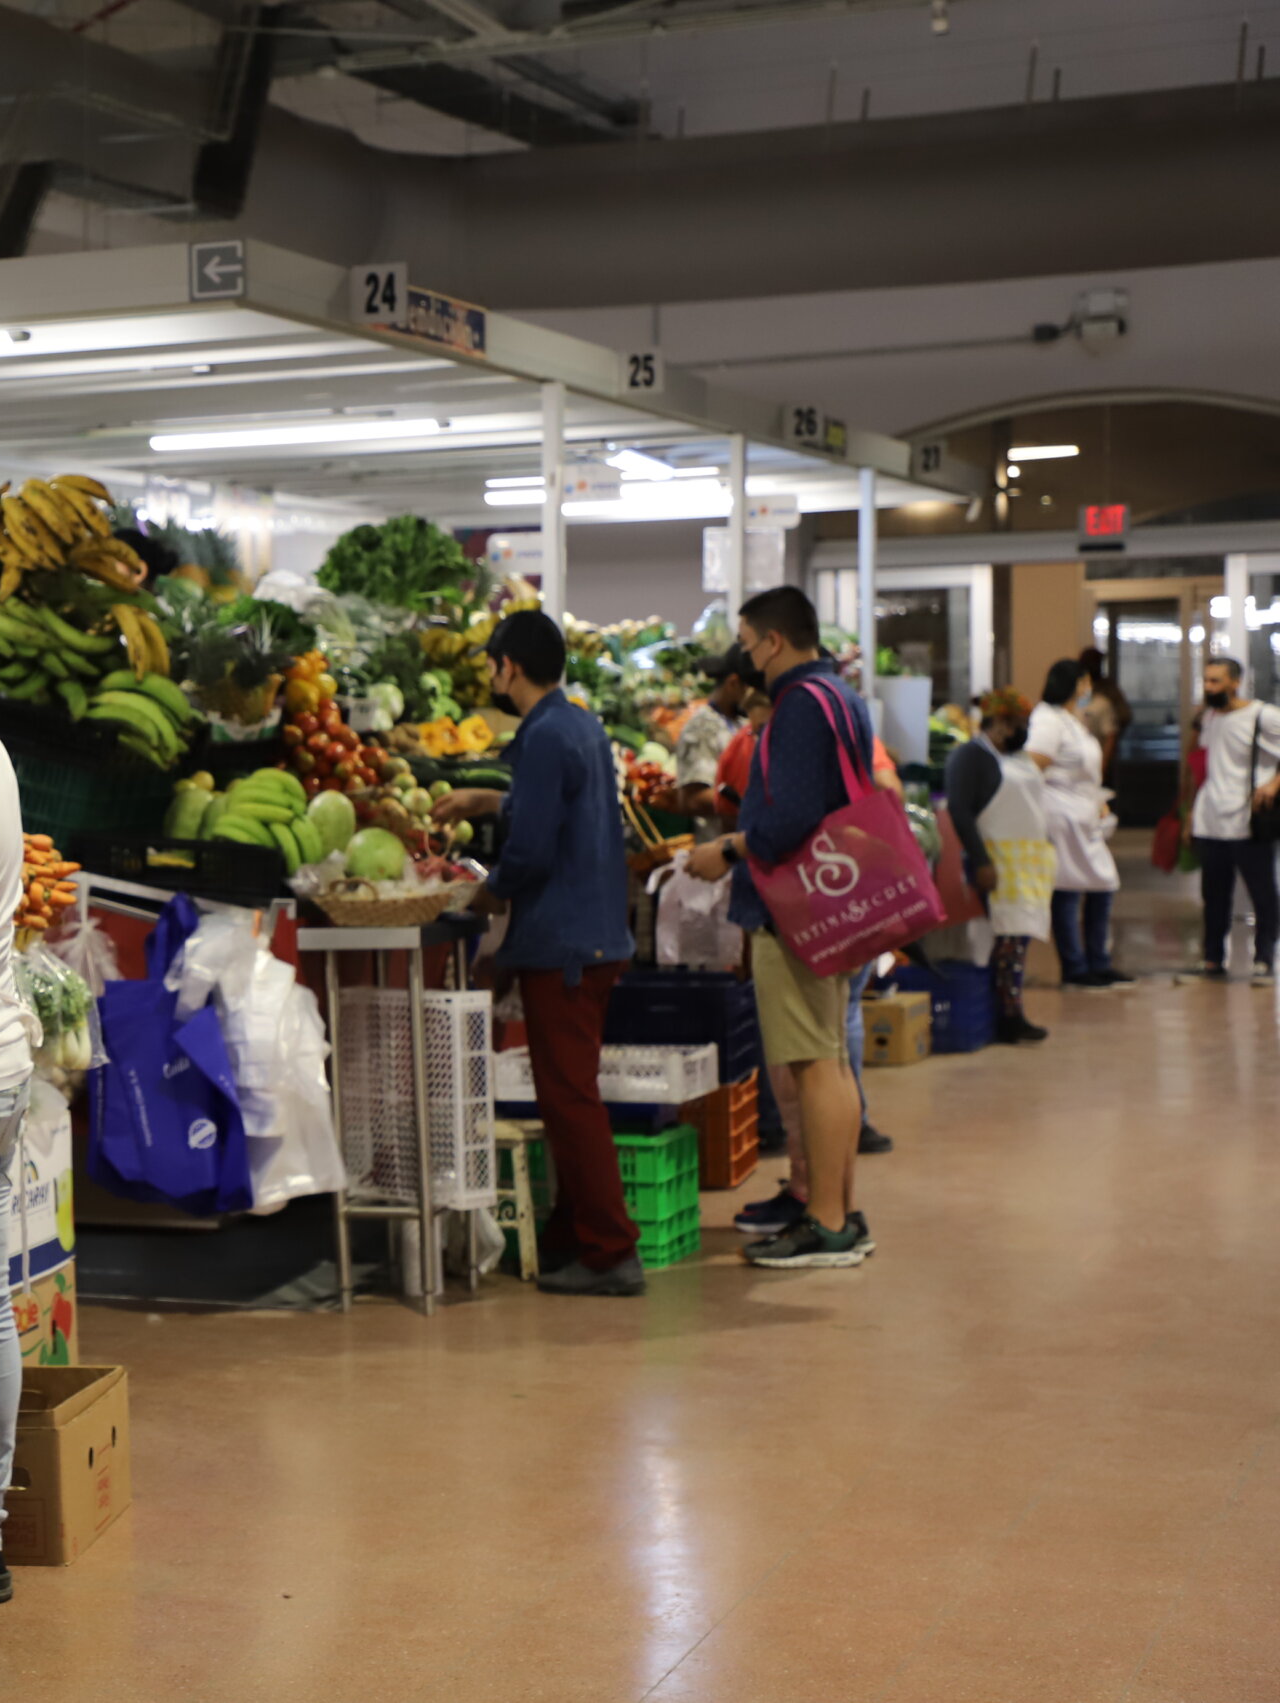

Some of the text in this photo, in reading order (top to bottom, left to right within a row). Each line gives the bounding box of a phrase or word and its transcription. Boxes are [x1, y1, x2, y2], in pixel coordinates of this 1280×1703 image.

[365, 272, 396, 314] 24
[629, 355, 655, 388] 25
[794, 407, 818, 437] 26
